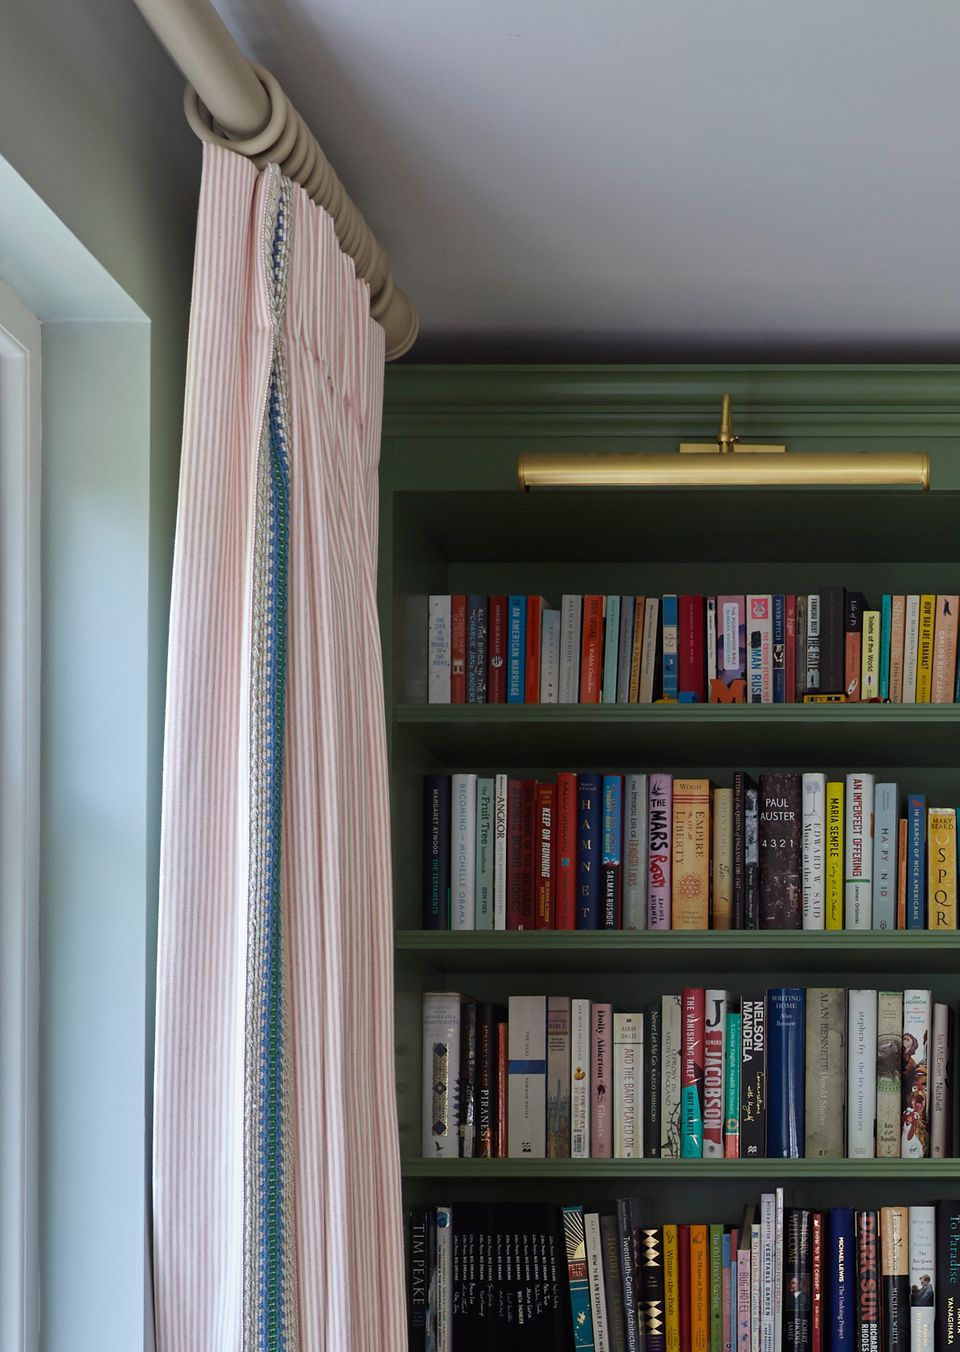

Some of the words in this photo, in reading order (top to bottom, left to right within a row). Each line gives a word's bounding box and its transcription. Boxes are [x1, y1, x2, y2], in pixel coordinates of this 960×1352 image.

[511, 607, 521, 617] AN
[511, 619, 521, 657] AMERICAN
[511, 659, 520, 697] MARRIAGE
[867, 657, 875, 672] World
[853, 778, 863, 790] AN
[459, 783, 467, 832] BECOMING
[481, 797, 491, 821] Fruit
[497, 796, 506, 840] ANGKOR
[542, 808, 551, 827] KEEP
[760, 812, 796, 821] AUSTER
[765, 798, 790, 808] PAUL
[830, 798, 839, 824] MARIA
[852, 792, 863, 836] IMPERFECT
[481, 822, 490, 845] Tree
[542, 829, 551, 841] ON
[650, 810, 668, 851] MARS
[675, 811, 685, 866] LIBERTY
[695, 811, 706, 859] EMPIRE
[804, 824, 812, 851] Music
[830, 826, 839, 858] SEMPLE
[541, 842, 551, 879] RUNNING
[814, 823, 822, 871] EDWARD
[852, 838, 863, 878] OFFERING
[606, 870, 615, 897] SALMAN
[606, 898, 614, 926] RUSHDIE
[803, 886, 812, 918] Limits
[686, 996, 695, 1011] THE
[820, 992, 830, 1019] ALAN
[597, 1010, 607, 1035] Dolly
[686, 1013, 695, 1056] VANISHING
[742, 1001, 754, 1063] MANDELA
[753, 1001, 764, 1052] NELSON
[856, 1011, 866, 1042] stephen
[598, 1038, 606, 1079] Alderton
[624, 1048, 634, 1065] AND
[820, 1023, 830, 1070] BENNETT
[936, 1046, 945, 1077] McEwan
[624, 1067, 634, 1080] THE
[687, 1058, 695, 1079] HALF
[624, 1083, 634, 1104] BAND
[703, 1047, 723, 1130] JACOBSON
[935, 1082, 944, 1113] Nutshell
[624, 1106, 634, 1135] PLAYED
[624, 1137, 634, 1149] ON
[413, 1223, 426, 1253] TIM
[950, 1215, 960, 1230] To
[860, 1215, 876, 1273] DARK
[949, 1233, 960, 1285] Paradise
[413, 1260, 426, 1305] PEAKE
[623, 1236, 634, 1307] Twentieth-Century
[667, 1249, 675, 1317] Winnie-the-Pooh
[837, 1296, 845, 1320] Undoing
[860, 1277, 877, 1321] SUN
[837, 1321, 845, 1340] Project
[947, 1296, 957, 1345] YANAGIHARA
[861, 1323, 870, 1352] RHODES
